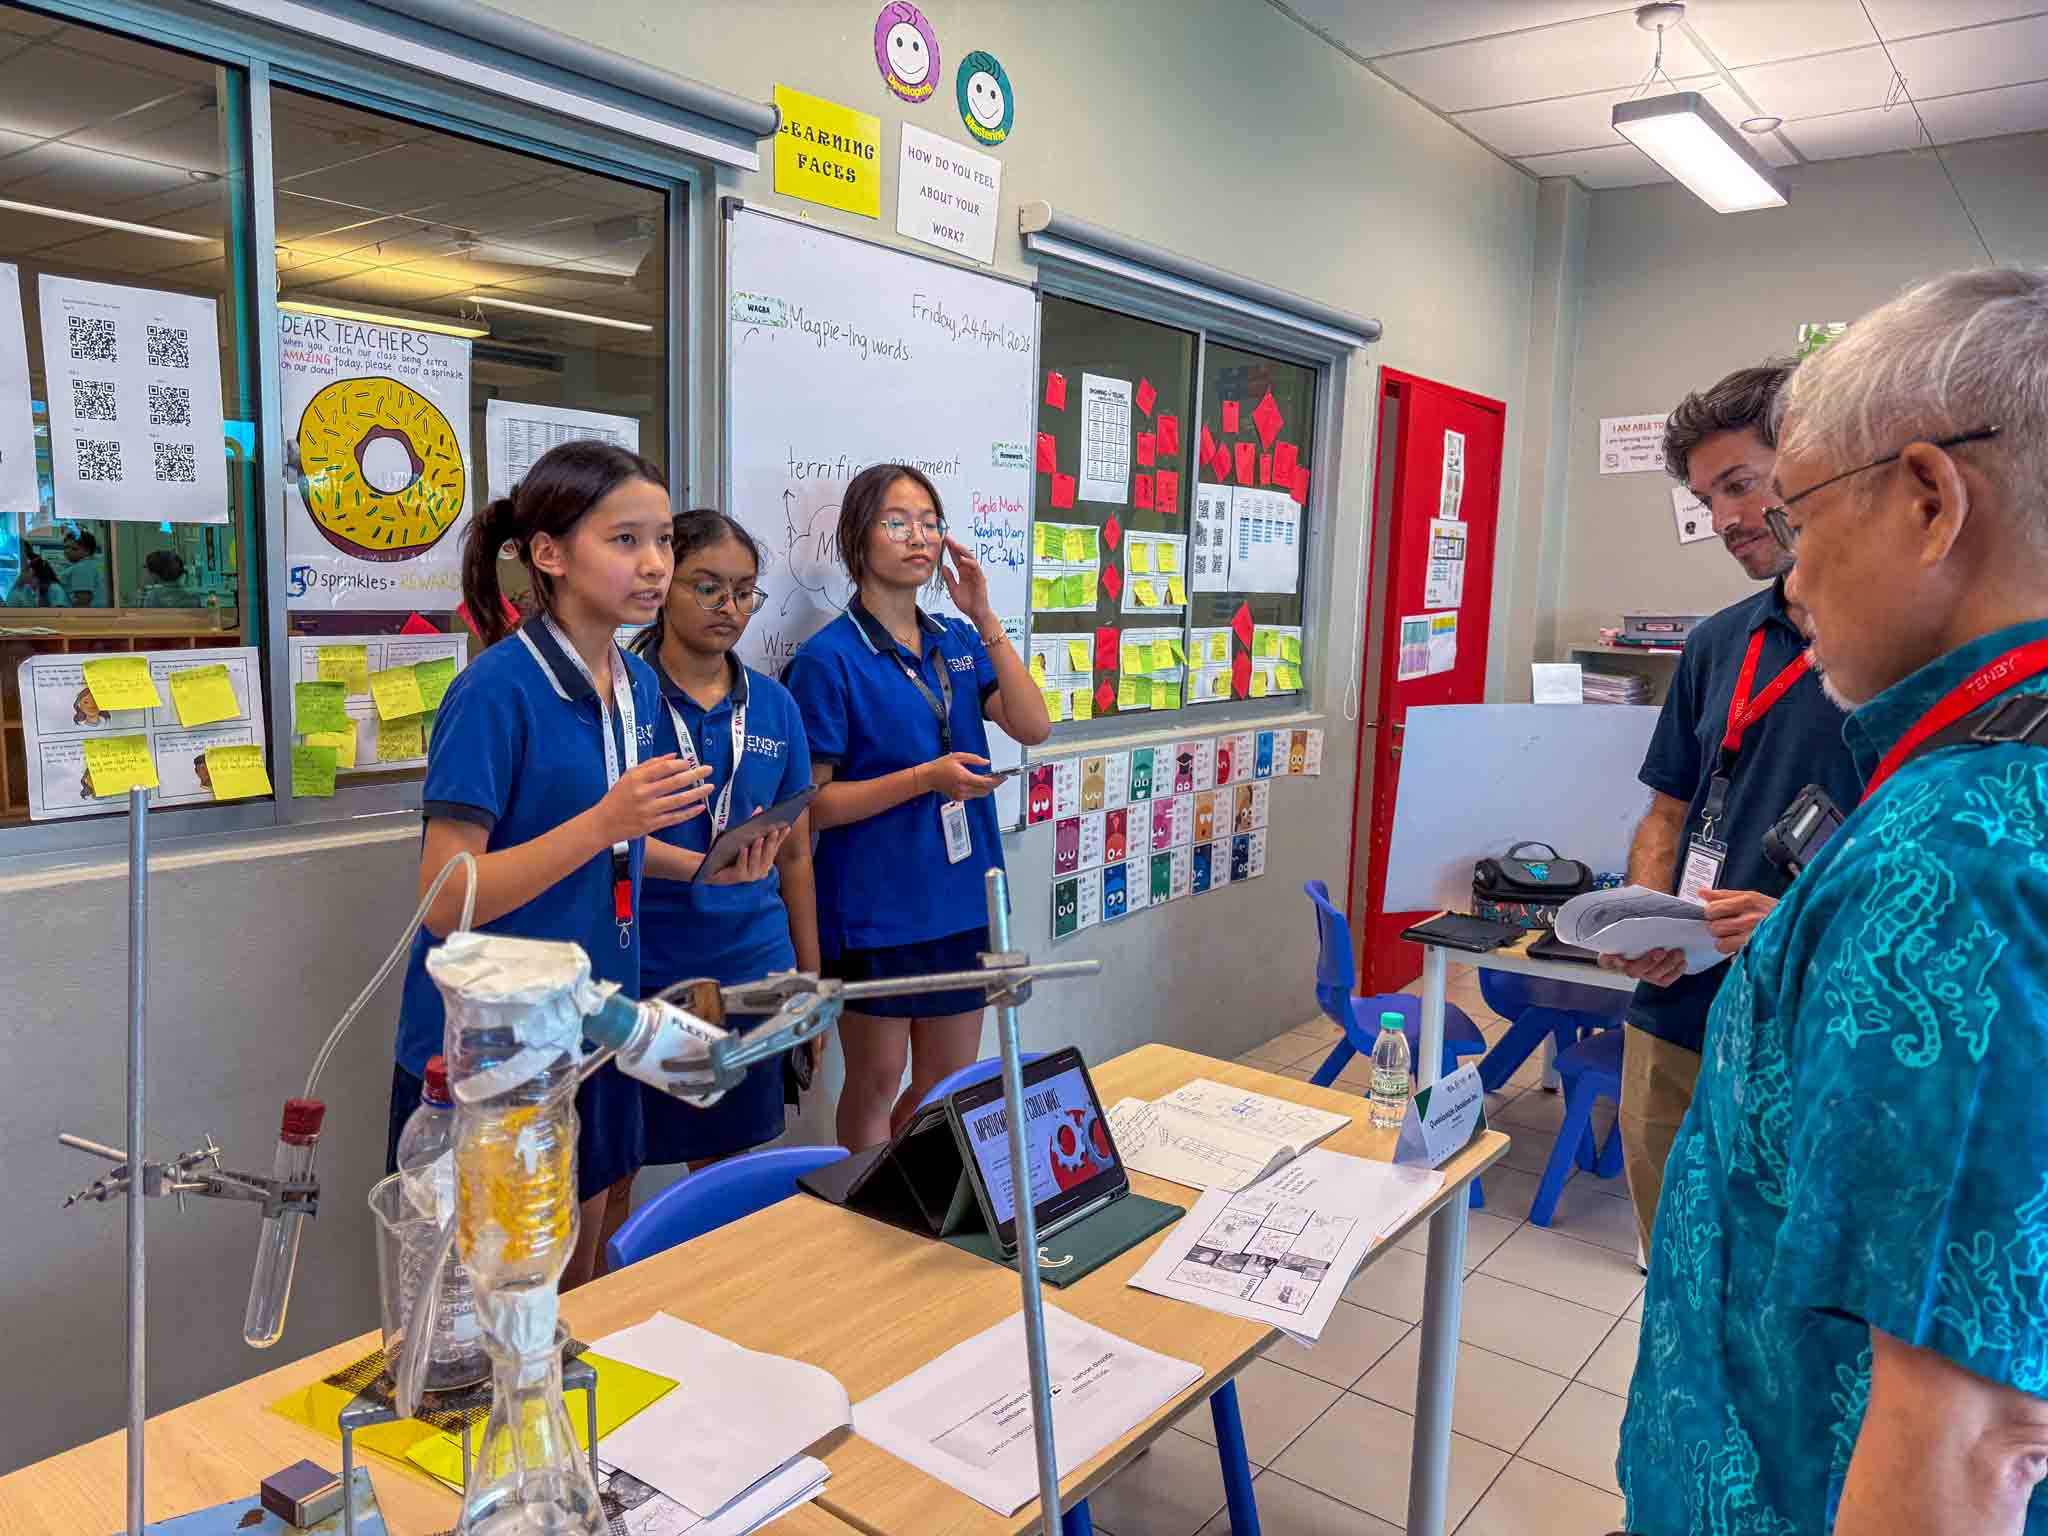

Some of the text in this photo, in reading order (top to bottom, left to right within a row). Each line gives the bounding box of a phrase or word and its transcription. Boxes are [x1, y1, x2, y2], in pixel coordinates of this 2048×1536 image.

[888, 72, 932, 98] Developing
[797, 152, 856, 183] FACES
[908, 145, 995, 189] HOW DO YOU FEEL
[920, 185, 980, 216] ABOUT YOUR
[932, 222, 965, 243] WORK?
[281, 316, 429, 356] DEAR TEACHERS
[962, 313, 979, 338] 24
[282, 350, 331, 366] AMAZING
[365, 362, 392, 373] please
[308, 342, 323, 354] you
[328, 343, 353, 356] catch
[358, 348, 371, 358] our
[376, 351, 398, 361] class
[402, 354, 423, 367] being
[321, 572, 388, 593] sprinkles
[1966, 652, 2022, 696] TENBY
